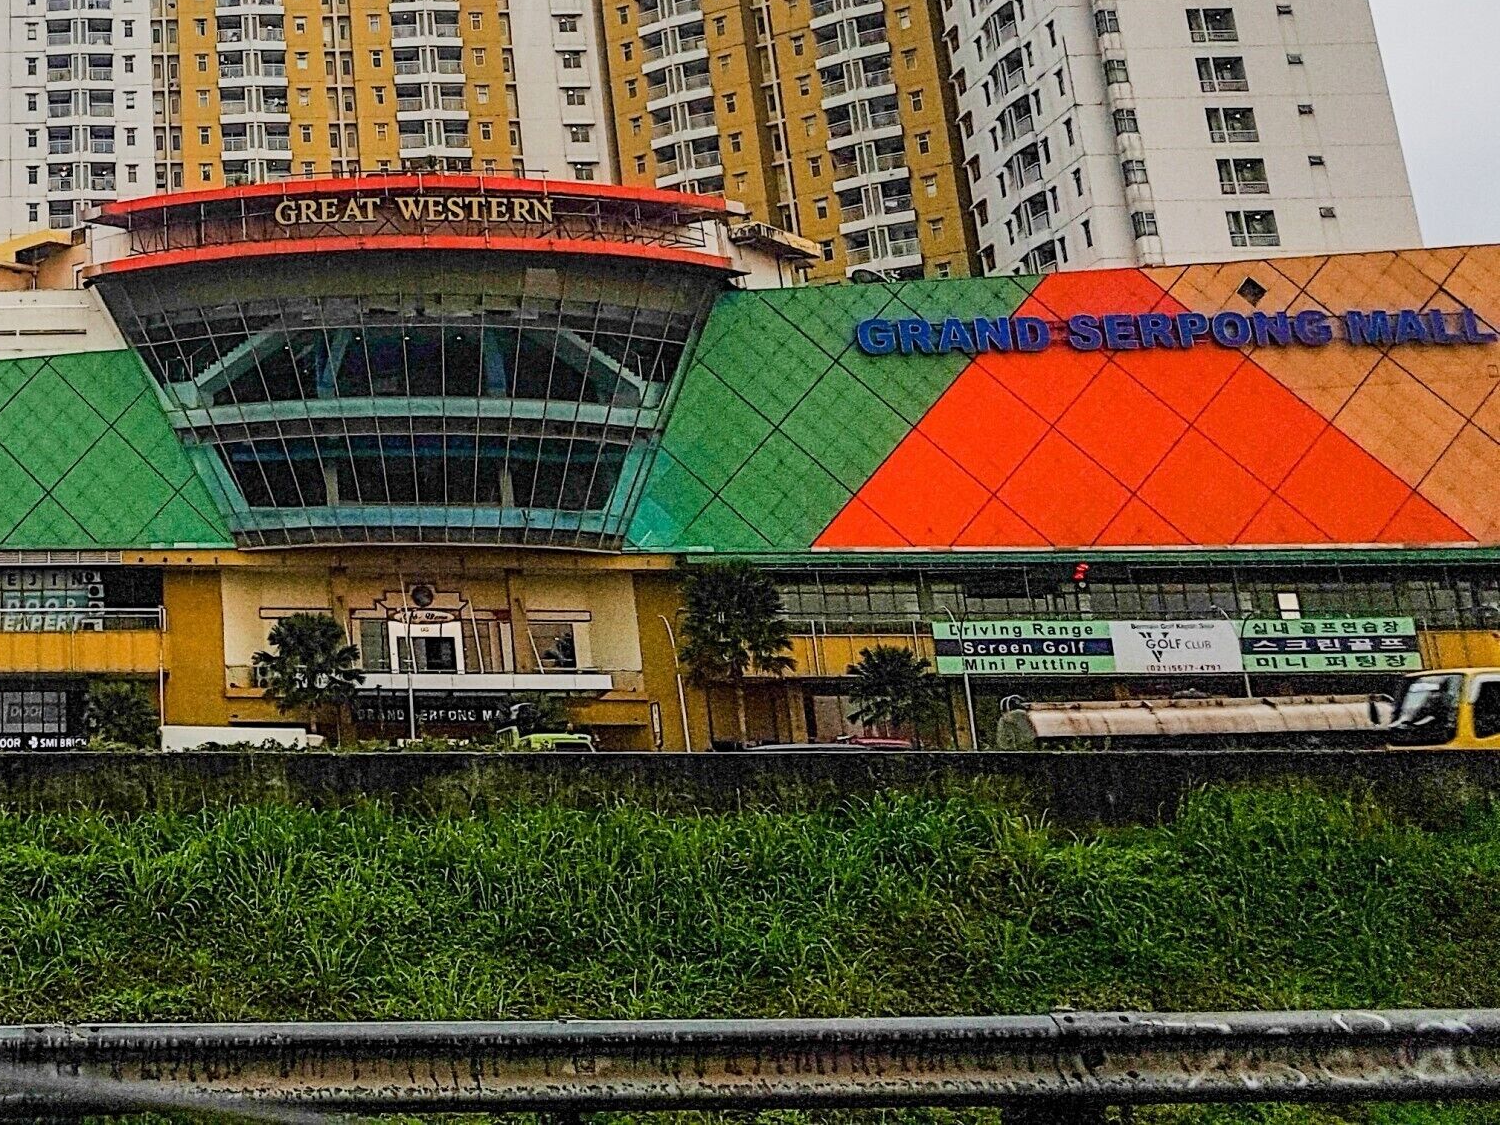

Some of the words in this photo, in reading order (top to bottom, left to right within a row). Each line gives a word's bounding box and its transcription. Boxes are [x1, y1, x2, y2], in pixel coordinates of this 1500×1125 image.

[274, 196, 381, 225] GREAT
[395, 196, 554, 223] WESTERN
[856, 315, 1051, 355] GRAND
[1067, 310, 1332, 350] SERPONG
[1344, 308, 1499, 347] MALL
[1032, 623, 1094, 637] Range
[1252, 622, 1290, 635] 실내
[964, 641, 1033, 654] Screen
[1043, 641, 1086, 654] Golf
[1146, 638, 1182, 650] GOLF
[1185, 640, 1212, 650] CLUB
[965, 659, 1006, 671] Mini
[1015, 658, 1090, 673] Putting
[1255, 656, 1309, 669] 미니
[40, 737, 58, 748] SMI
